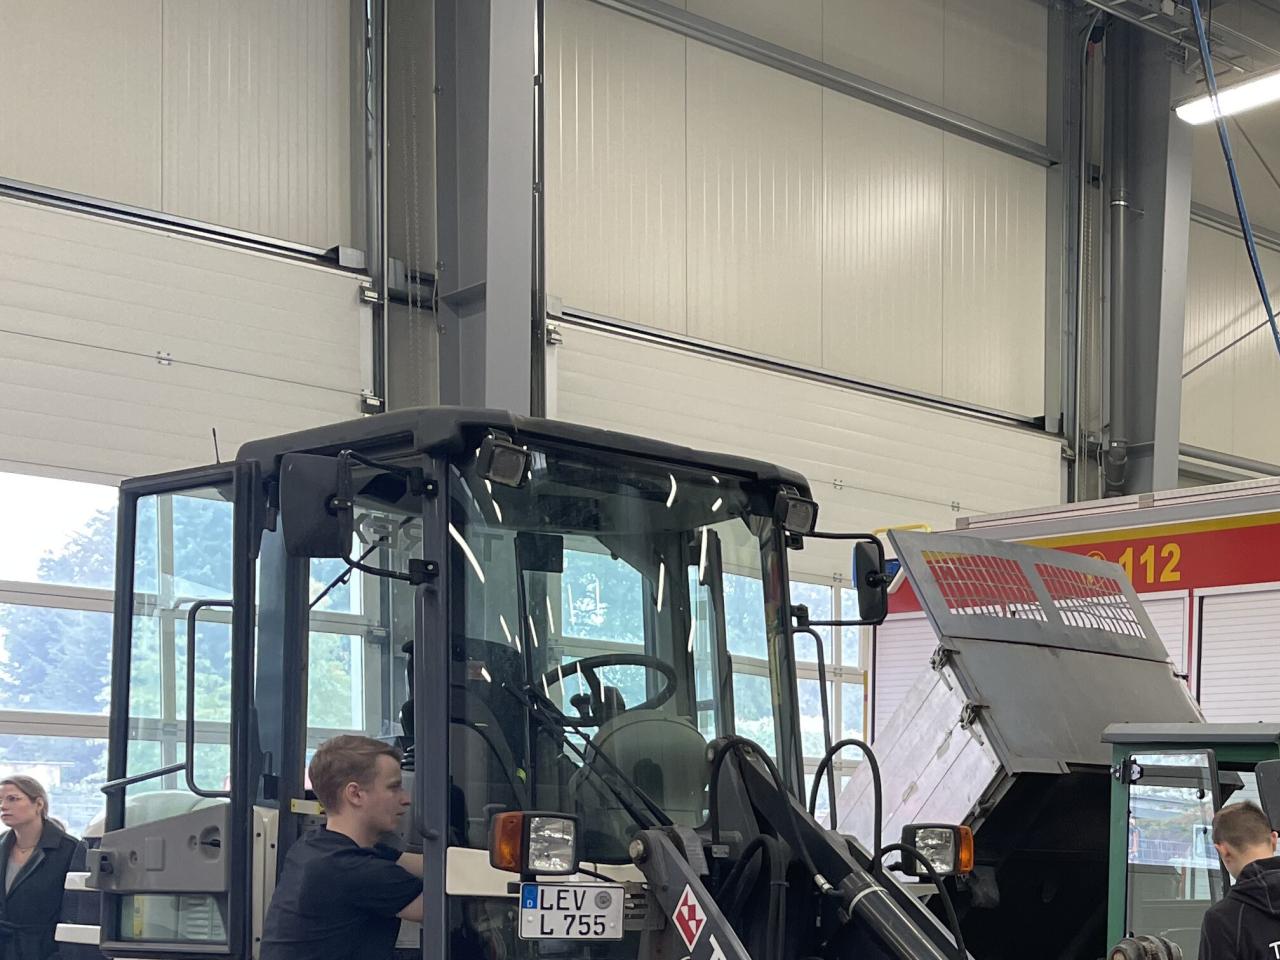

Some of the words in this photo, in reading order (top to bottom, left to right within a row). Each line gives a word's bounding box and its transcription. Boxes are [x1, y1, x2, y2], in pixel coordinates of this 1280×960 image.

[1118, 543, 1181, 584] 112
[540, 889, 587, 911] LEV
[540, 914, 554, 936] L
[563, 914, 607, 936] 755
